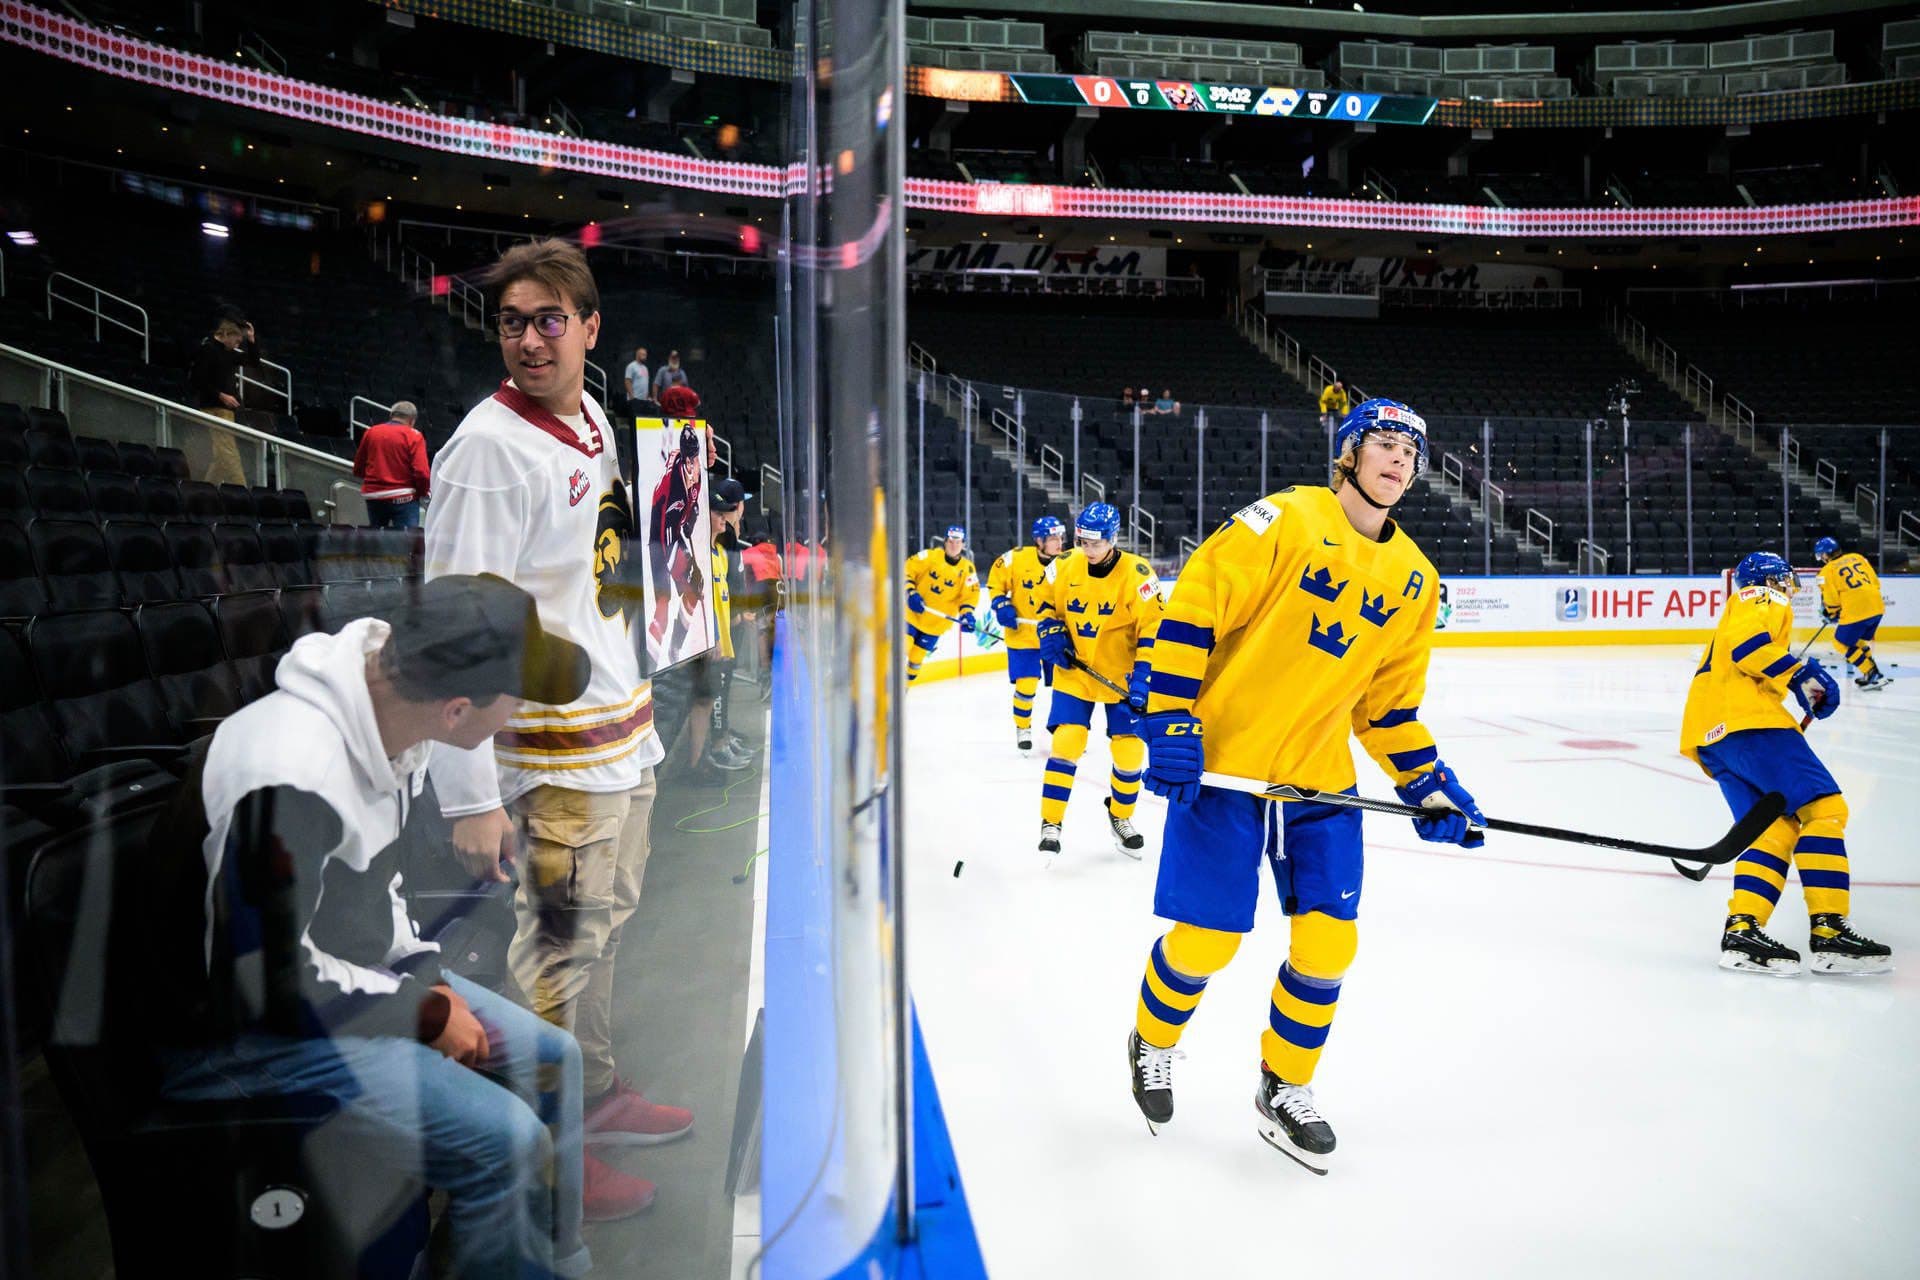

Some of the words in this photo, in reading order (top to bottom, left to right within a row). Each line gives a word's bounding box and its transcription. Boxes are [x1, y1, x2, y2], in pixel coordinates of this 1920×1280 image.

[1094, 81, 1111, 102] 0
[1137, 90, 1149, 104] 0
[1209, 86, 1251, 103] 39:02
[1310, 100, 1321, 114] 0
[1346, 95, 1361, 116] 0
[1402, 569, 1424, 600] A
[1839, 562, 1871, 589] 25
[1592, 589, 1654, 618] IIHF
[273, 1201, 282, 1217] 1
